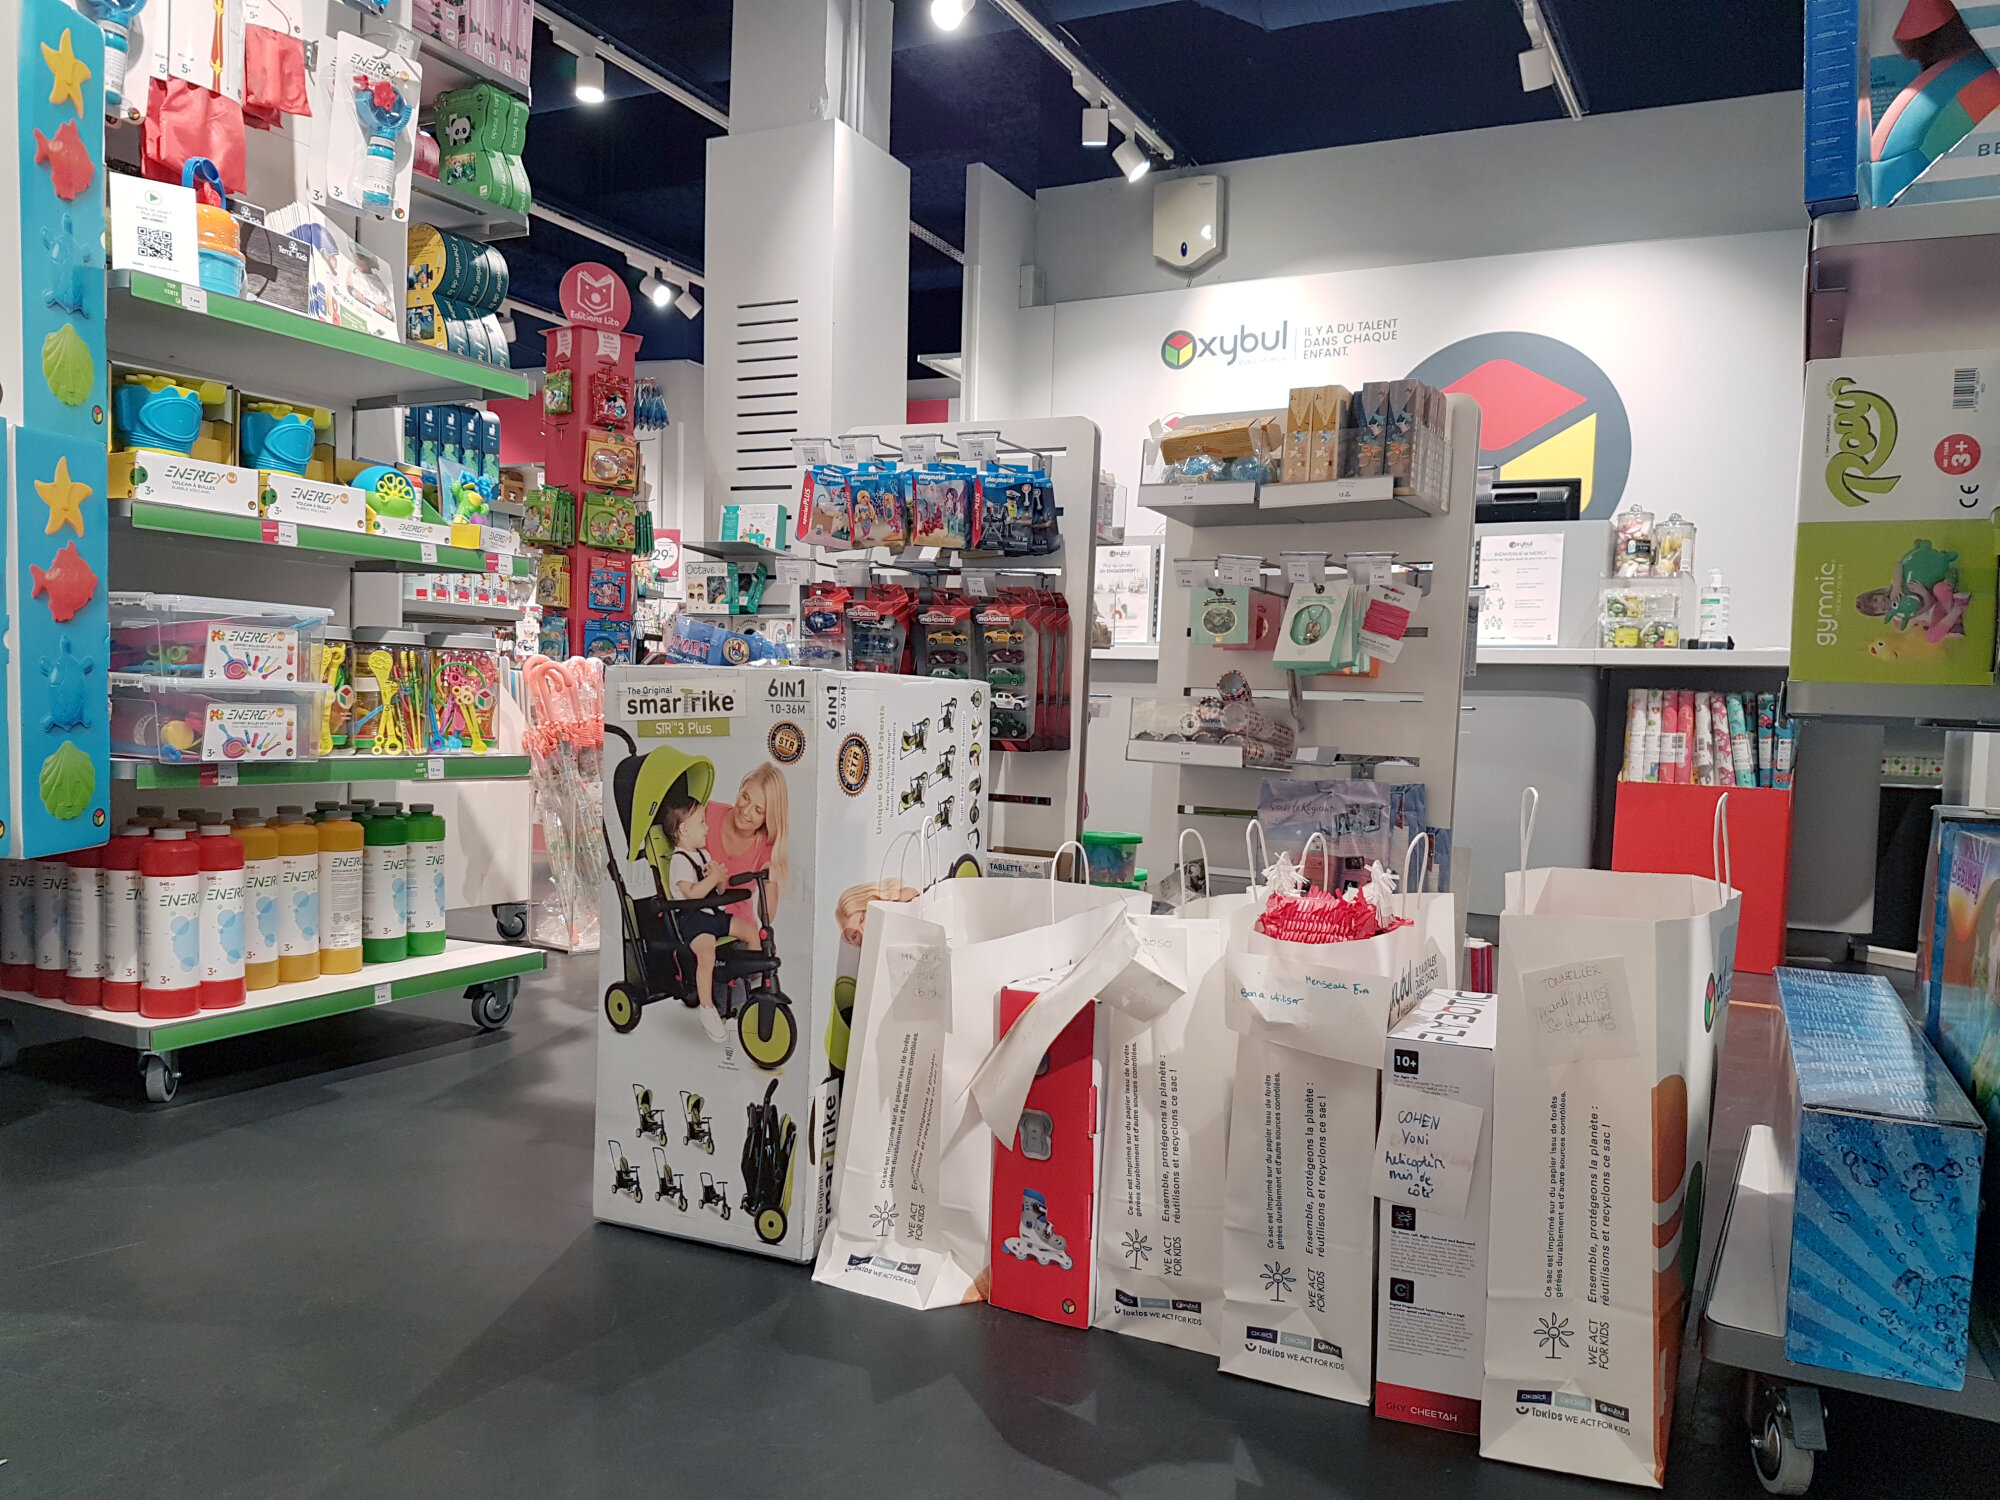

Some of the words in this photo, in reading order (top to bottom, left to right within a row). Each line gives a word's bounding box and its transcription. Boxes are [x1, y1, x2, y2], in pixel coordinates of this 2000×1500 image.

[570, 309, 603, 324] Editions
[603, 316, 620, 327] Lito
[1304, 327, 1314, 337] IL
[1316, 326, 1324, 335] Y
[1326, 325, 1334, 334] A
[1337, 323, 1354, 333] DU
[1357, 318, 1399, 332] TALENT
[1304, 337, 1338, 348] DANS
[1343, 330, 1398, 345] CHAQUE
[1303, 346, 1349, 360] ENFANT.
[1951, 440, 1972, 467] 3+
[164, 466, 225, 485] ENERGY
[851, 474, 879, 483] playmobil
[918, 473, 946, 482] playmobil
[984, 475, 1015, 484] playmobil
[144, 486, 154, 495] 3+
[171, 480, 192, 488] VOLCAN
[198, 483, 216, 491] BULLES
[290, 487, 338, 504] ENERGY
[1959, 484, 1980, 508] CE
[274, 506, 283, 515] 3+
[651, 549, 669, 561] 29
[685, 564, 715, 575] Octave
[1815, 562, 1838, 646] gymnic
[228, 630, 276, 644] ENERGY
[208, 669, 217, 678] 3+
[627, 686, 641, 695] The
[642, 685, 673, 696] Original
[767, 678, 805, 698] 6IN1
[627, 688, 734, 715] smarTrike
[770, 703, 806, 715] 10-36M
[826, 685, 838, 730] 6IN1
[226, 709, 276, 721] ENERGY
[688, 721, 712, 735] Plus
[778, 736, 795, 749] STR
[206, 749, 216, 757] 3+
[849, 751, 860, 777] STR
[876, 797, 885, 835] Unique
[989, 862, 1023, 873] TABLETTE
[383, 927, 391, 935] 3+
[246, 951, 256, 959] 3+
[284, 944, 294, 952] 3+
[125, 968, 136, 977] 3+
[160, 976, 170, 985] 3+
[207, 967, 217, 976] 3+
[1240, 987, 1257, 998] Bon
[1395, 1055, 1417, 1068] 10+
[1305, 1088, 1316, 1124] planète
[1318, 1102, 1326, 1118] sac
[1550, 1096, 1560, 1121] forêts
[1559, 1091, 1569, 1135] contrôlées.
[1319, 1121, 1326, 1133] ce
[1398, 1110, 1441, 1130] COHEN
[1550, 1123, 1557, 1134] de
[1305, 1126, 1313, 1136] la
[1590, 1112, 1601, 1156] planète
[1549, 1136, 1557, 1154] issu
[1559, 1137, 1568, 1169] sources
[823, 1094, 838, 1228] marTrike
[1304, 1138, 1315, 1198] protégeons
[1316, 1136, 1327, 1186] recyclons
[1548, 1156, 1557, 1184] papier
[1590, 1159, 1597, 1169] la
[1603, 1154, 1610, 1168] ce
[1317, 1188, 1325, 1199] et
[1548, 1186, 1555, 1198] du
[1602, 1171, 1612, 1227] recyclons
[909, 1202, 918, 1221] ACT
[916, 1204, 926, 1221] KIDS
[1557, 1200, 1564, 1210] et
[1588, 1173, 1600, 1239] protégeons
[907, 1222, 916, 1238] WE
[914, 1221, 923, 1241] FOR
[1304, 1201, 1314, 1254] Ensemble,
[1316, 1202, 1326, 1258] réutilisons
[1546, 1216, 1555, 1252] imprimé
[1601, 1230, 1610, 1242] et
[1163, 1235, 1173, 1256] ACT
[1173, 1236, 1182, 1257] KIDS
[1556, 1211, 1564, 1266] durablement
[1163, 1258, 1173, 1275] WE
[1173, 1258, 1182, 1276] FOR
[1546, 1254, 1554, 1267] est
[1307, 1267, 1316, 1290] ACT
[1587, 1243, 1598, 1303] Ensemble,
[1601, 1244, 1612, 1306] réutilisons
[1316, 1271, 1326, 1294] KIDS
[1544, 1285, 1552, 1297] Ce
[1555, 1268, 1564, 1297] gérées
[1308, 1290, 1316, 1308] WE
[1316, 1293, 1326, 1313] FOR
[1149, 1311, 1161, 1319] WE
[1174, 1314, 1187, 1323] FOR
[1187, 1316, 1202, 1326] KIDS
[1588, 1318, 1598, 1343] ACT
[1599, 1321, 1610, 1346] KIDS
[1286, 1352, 1299, 1361] WE
[1300, 1356, 1314, 1365] ACT
[1314, 1358, 1329, 1367] FOR
[1329, 1361, 1345, 1370] KIDS
[1588, 1344, 1598, 1365] WE
[1598, 1349, 1609, 1370] FOR
[1410, 1406, 1458, 1422] CHEETAH
[1564, 1414, 1579, 1424] WE
[1580, 1418, 1596, 1428] ACT
[1597, 1420, 1614, 1430] FOR
[1614, 1425, 1631, 1436] KIDS
